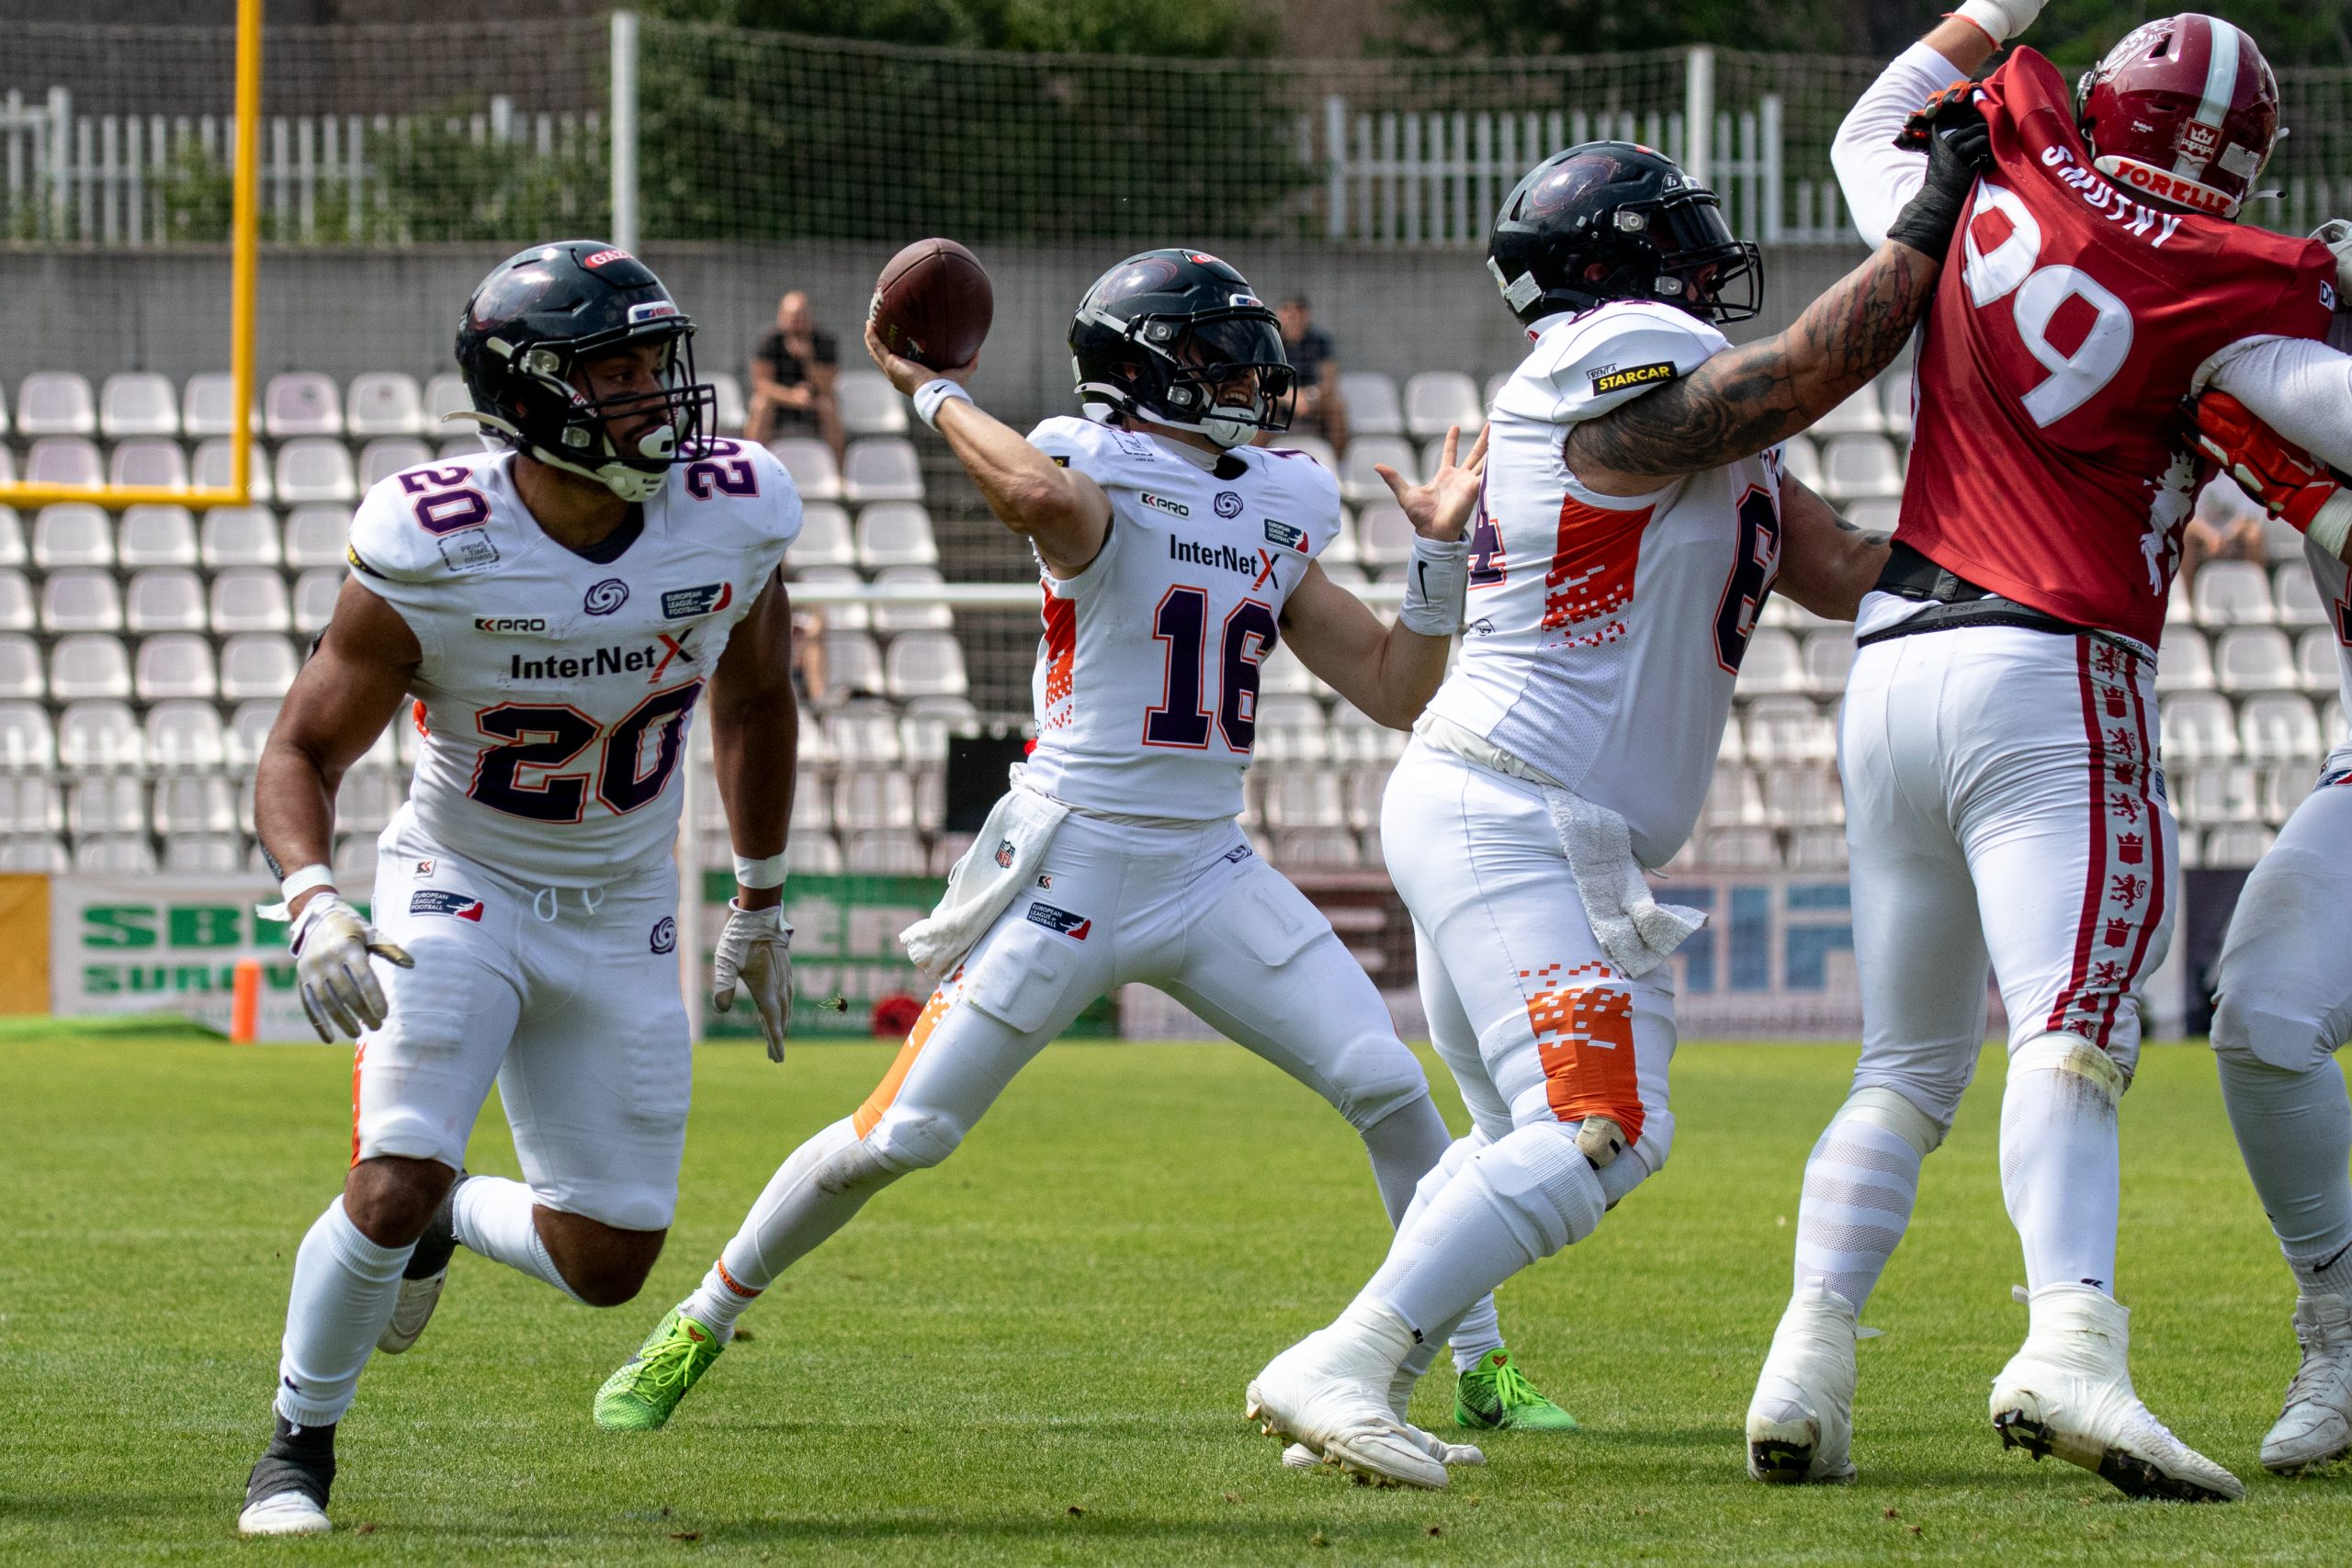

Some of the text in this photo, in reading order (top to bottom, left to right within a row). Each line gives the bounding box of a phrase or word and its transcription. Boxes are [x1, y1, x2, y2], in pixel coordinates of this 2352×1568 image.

[2113, 161, 2233, 217] FORELLE
[1961, 178, 2134, 429] 99
[1600, 366, 1670, 390] STARCAR
[398, 467, 492, 537] 20
[1170, 533, 1281, 592] InterNetX
[666, 591, 703, 602] EUROPEAN
[667, 599, 693, 608] LEAGUE
[669, 605, 703, 615] FOOTBALL
[511, 628, 695, 684] InterNetX
[1142, 584, 1280, 754] 16
[466, 676, 706, 824] 20
[413, 892, 448, 900] EUROPEAN
[1029, 914, 1057, 928] FOOTBALL
[1030, 909, 1052, 920] LEAGUE
[1032, 904, 1063, 918] EUROPEAN
